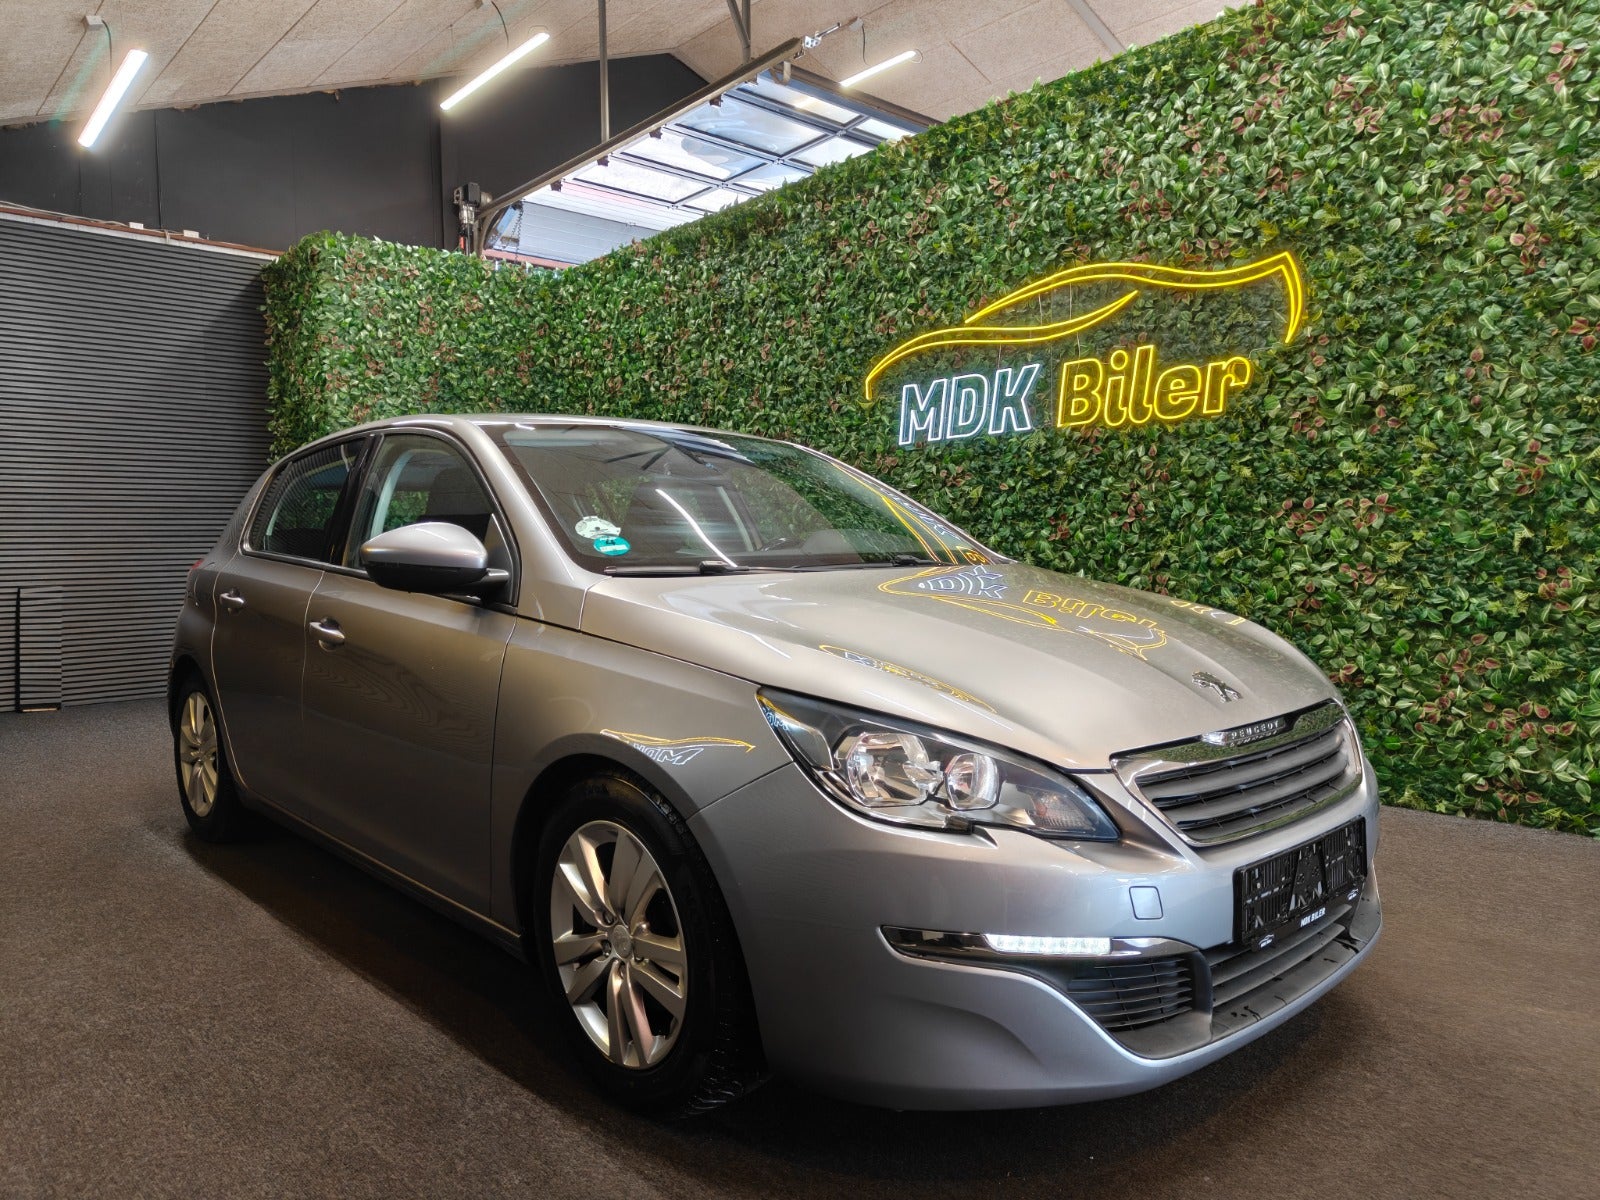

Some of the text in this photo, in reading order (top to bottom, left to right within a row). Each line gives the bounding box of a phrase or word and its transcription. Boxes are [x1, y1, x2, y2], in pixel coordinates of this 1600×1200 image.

[898, 344, 1252, 446] MDK Biler
[1231, 720, 1279, 740] PEUGEOT
